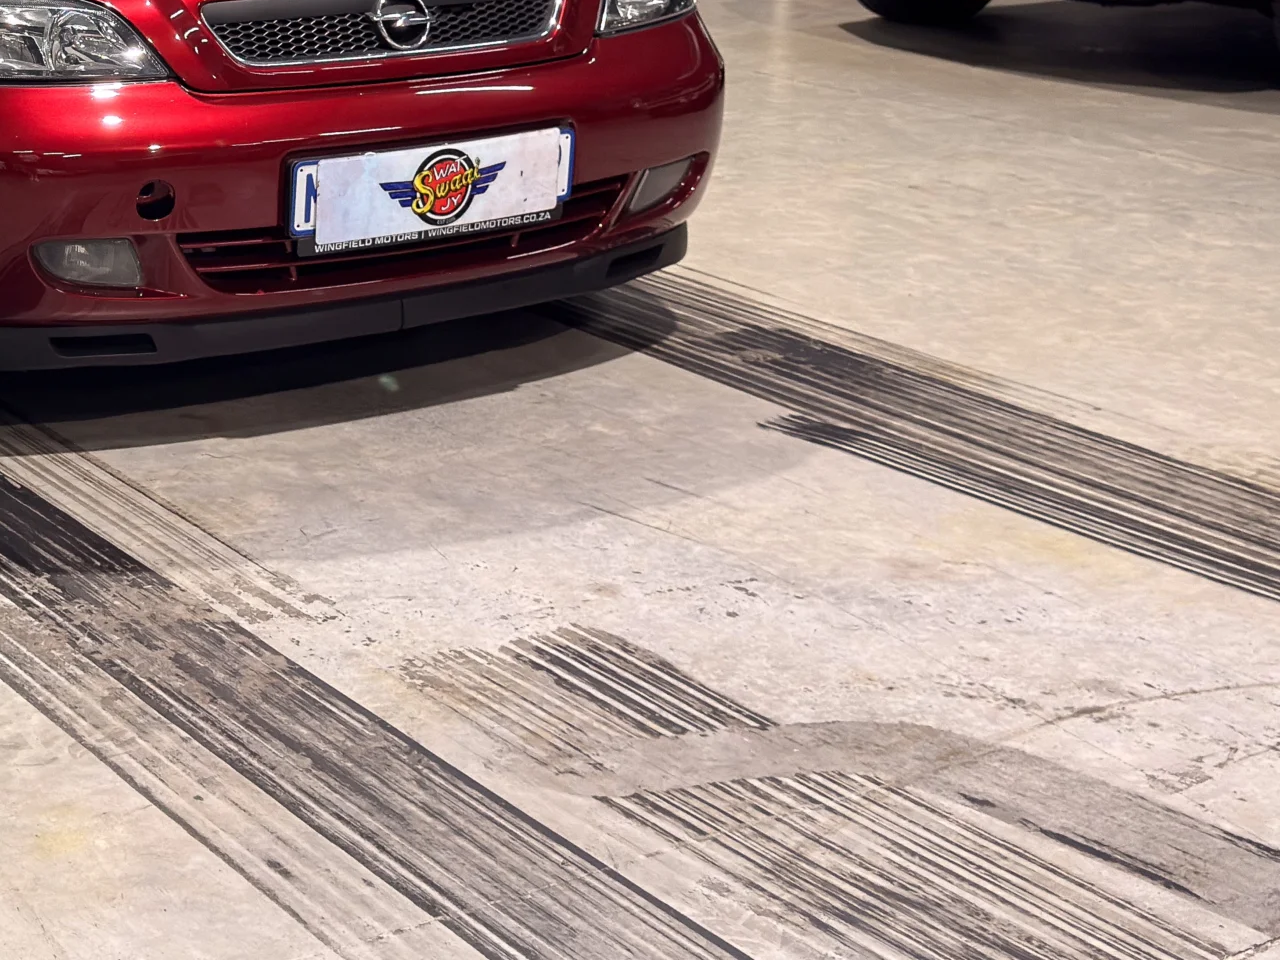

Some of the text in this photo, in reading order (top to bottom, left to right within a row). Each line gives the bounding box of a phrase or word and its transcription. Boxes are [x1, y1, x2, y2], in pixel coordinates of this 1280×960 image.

[433, 154, 468, 180] WAT
[441, 193, 462, 211] JY
[314, 211, 552, 253] WINGFIELD MOTORS WINGFIELDMOTORS.CO.ZA
